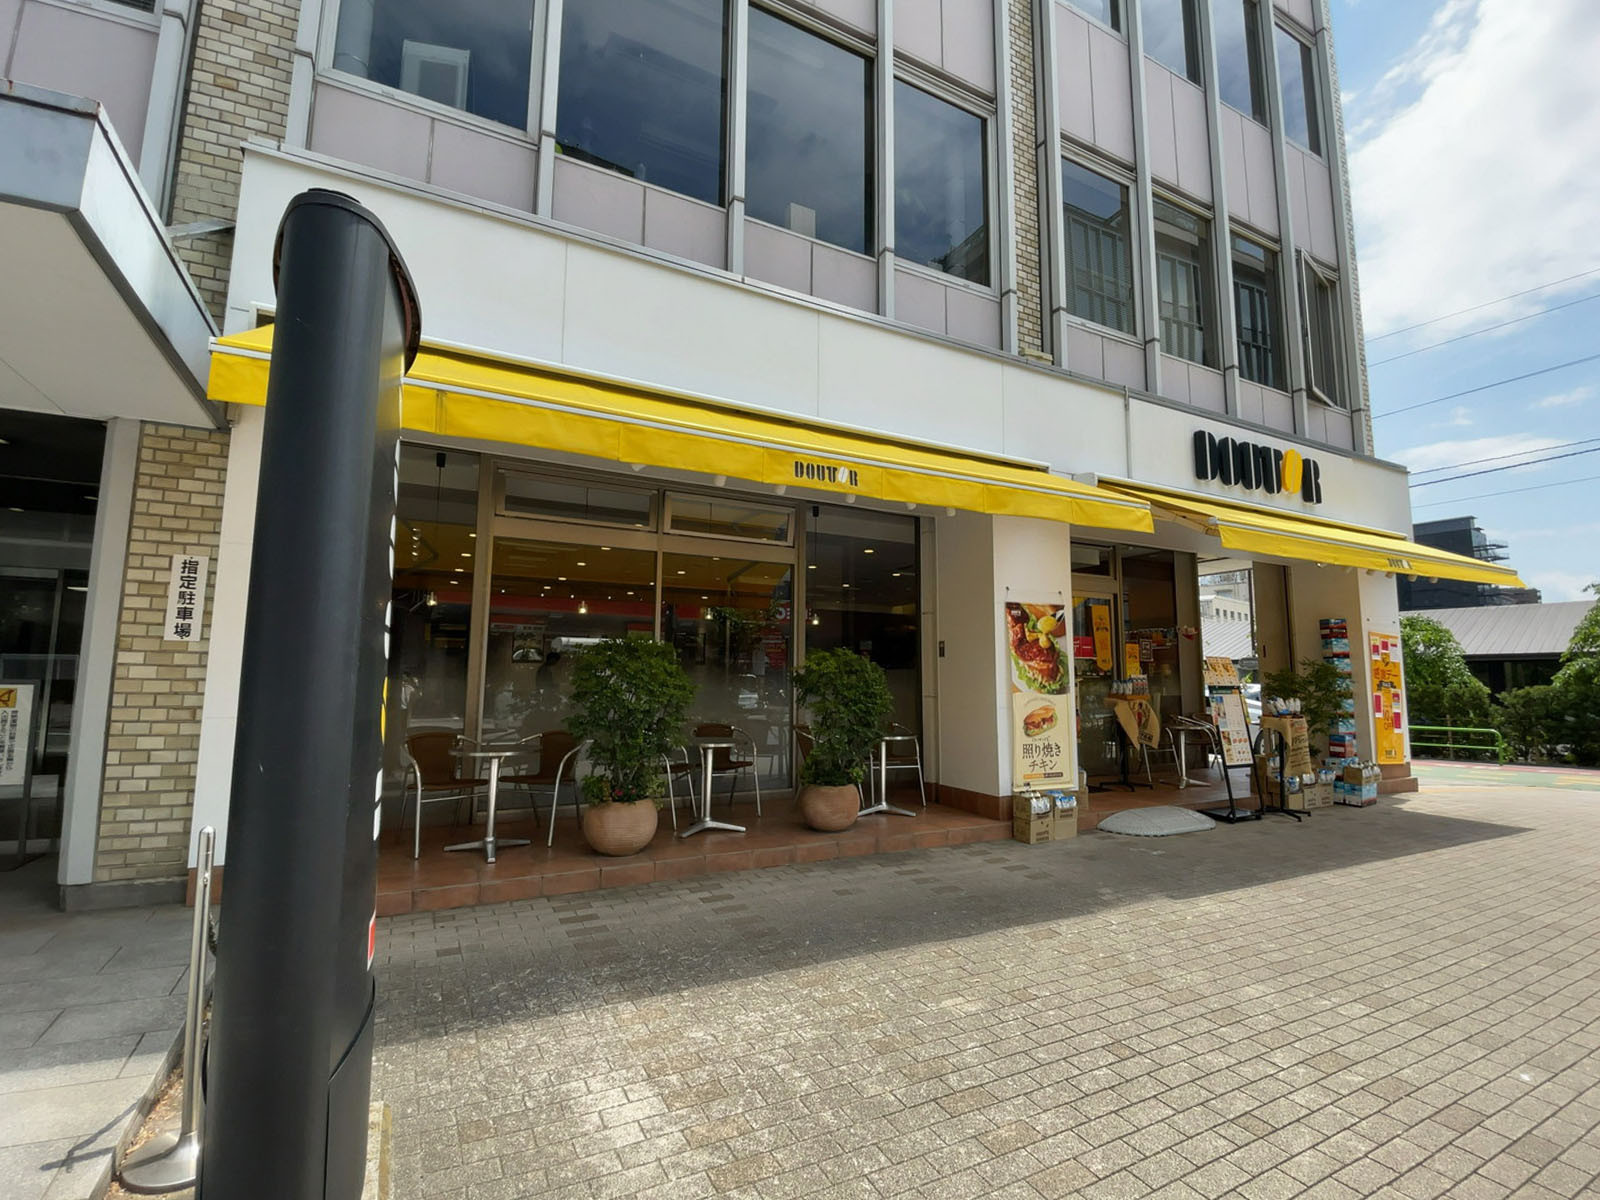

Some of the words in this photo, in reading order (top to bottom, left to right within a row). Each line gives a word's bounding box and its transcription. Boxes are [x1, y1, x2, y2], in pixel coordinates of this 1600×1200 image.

[794, 460, 858, 487] DOUTOR
[1193, 429, 1322, 504] DOUTOR
[173, 559, 199, 638] 指定駐車場
[1022, 742, 1061, 759] 照り焼き
[1028, 759, 1057, 773] チキン
